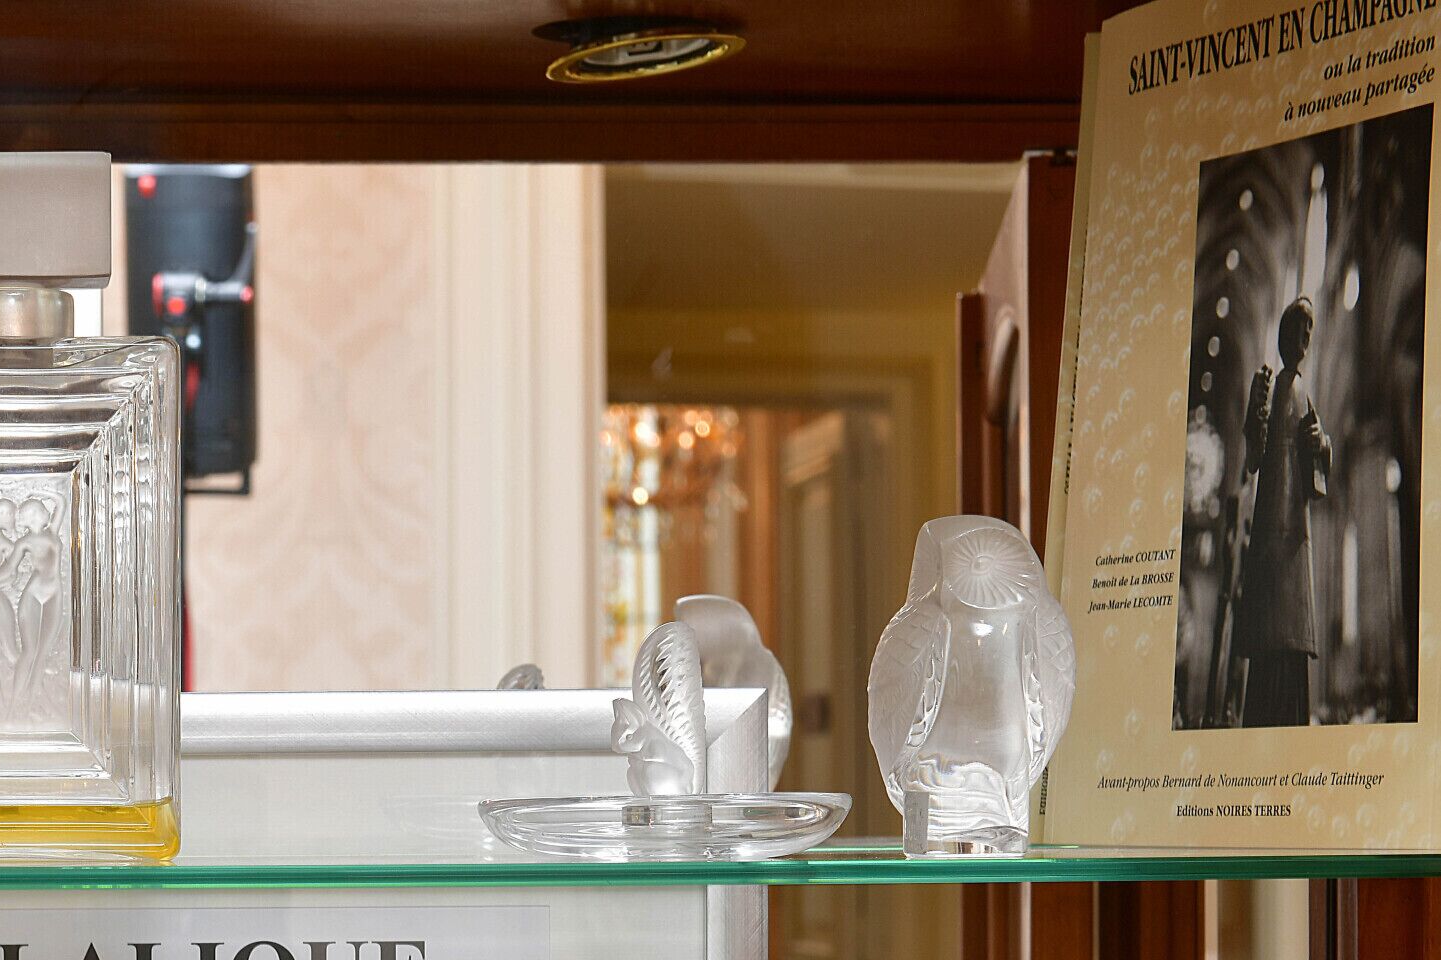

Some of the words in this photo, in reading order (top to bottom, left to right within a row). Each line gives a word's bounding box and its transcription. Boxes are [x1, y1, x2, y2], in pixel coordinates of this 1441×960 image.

[1128, 15, 1275, 95] SAINT-VINCENT
[1277, 7, 1306, 55] EN
[1309, 0, 1440, 45] CHAMPAGNE
[1324, 60, 1344, 81] ou
[1347, 53, 1362, 74] la
[1365, 35, 1436, 70] tradition
[1284, 101, 1294, 122] à
[1297, 87, 1362, 119] nouveau
[1363, 63, 1436, 107] partagée
[1095, 554, 1133, 567] Catherine
[1135, 549, 1176, 562] COUTANT
[1119, 576, 1128, 586] de
[1130, 576, 1140, 585] La
[1142, 572, 1174, 584] BROSSE
[1088, 600, 1132, 614] Jean-Marie
[1133, 596, 1173, 608] LECOMTE
[1097, 776, 1160, 792] Avant-propos
[1162, 774, 1203, 789] Bernard
[1203, 774, 1216, 788] de
[1217, 773, 1278, 788] Nonancourt
[1279, 775, 1290, 787] et
[1291, 772, 1328, 787] Claude
[1330, 772, 1385, 790] Taittinger
[1176, 804, 1214, 817] Editions
[1216, 805, 1253, 817] NOIRES
[1254, 805, 1292, 817] TERRES
